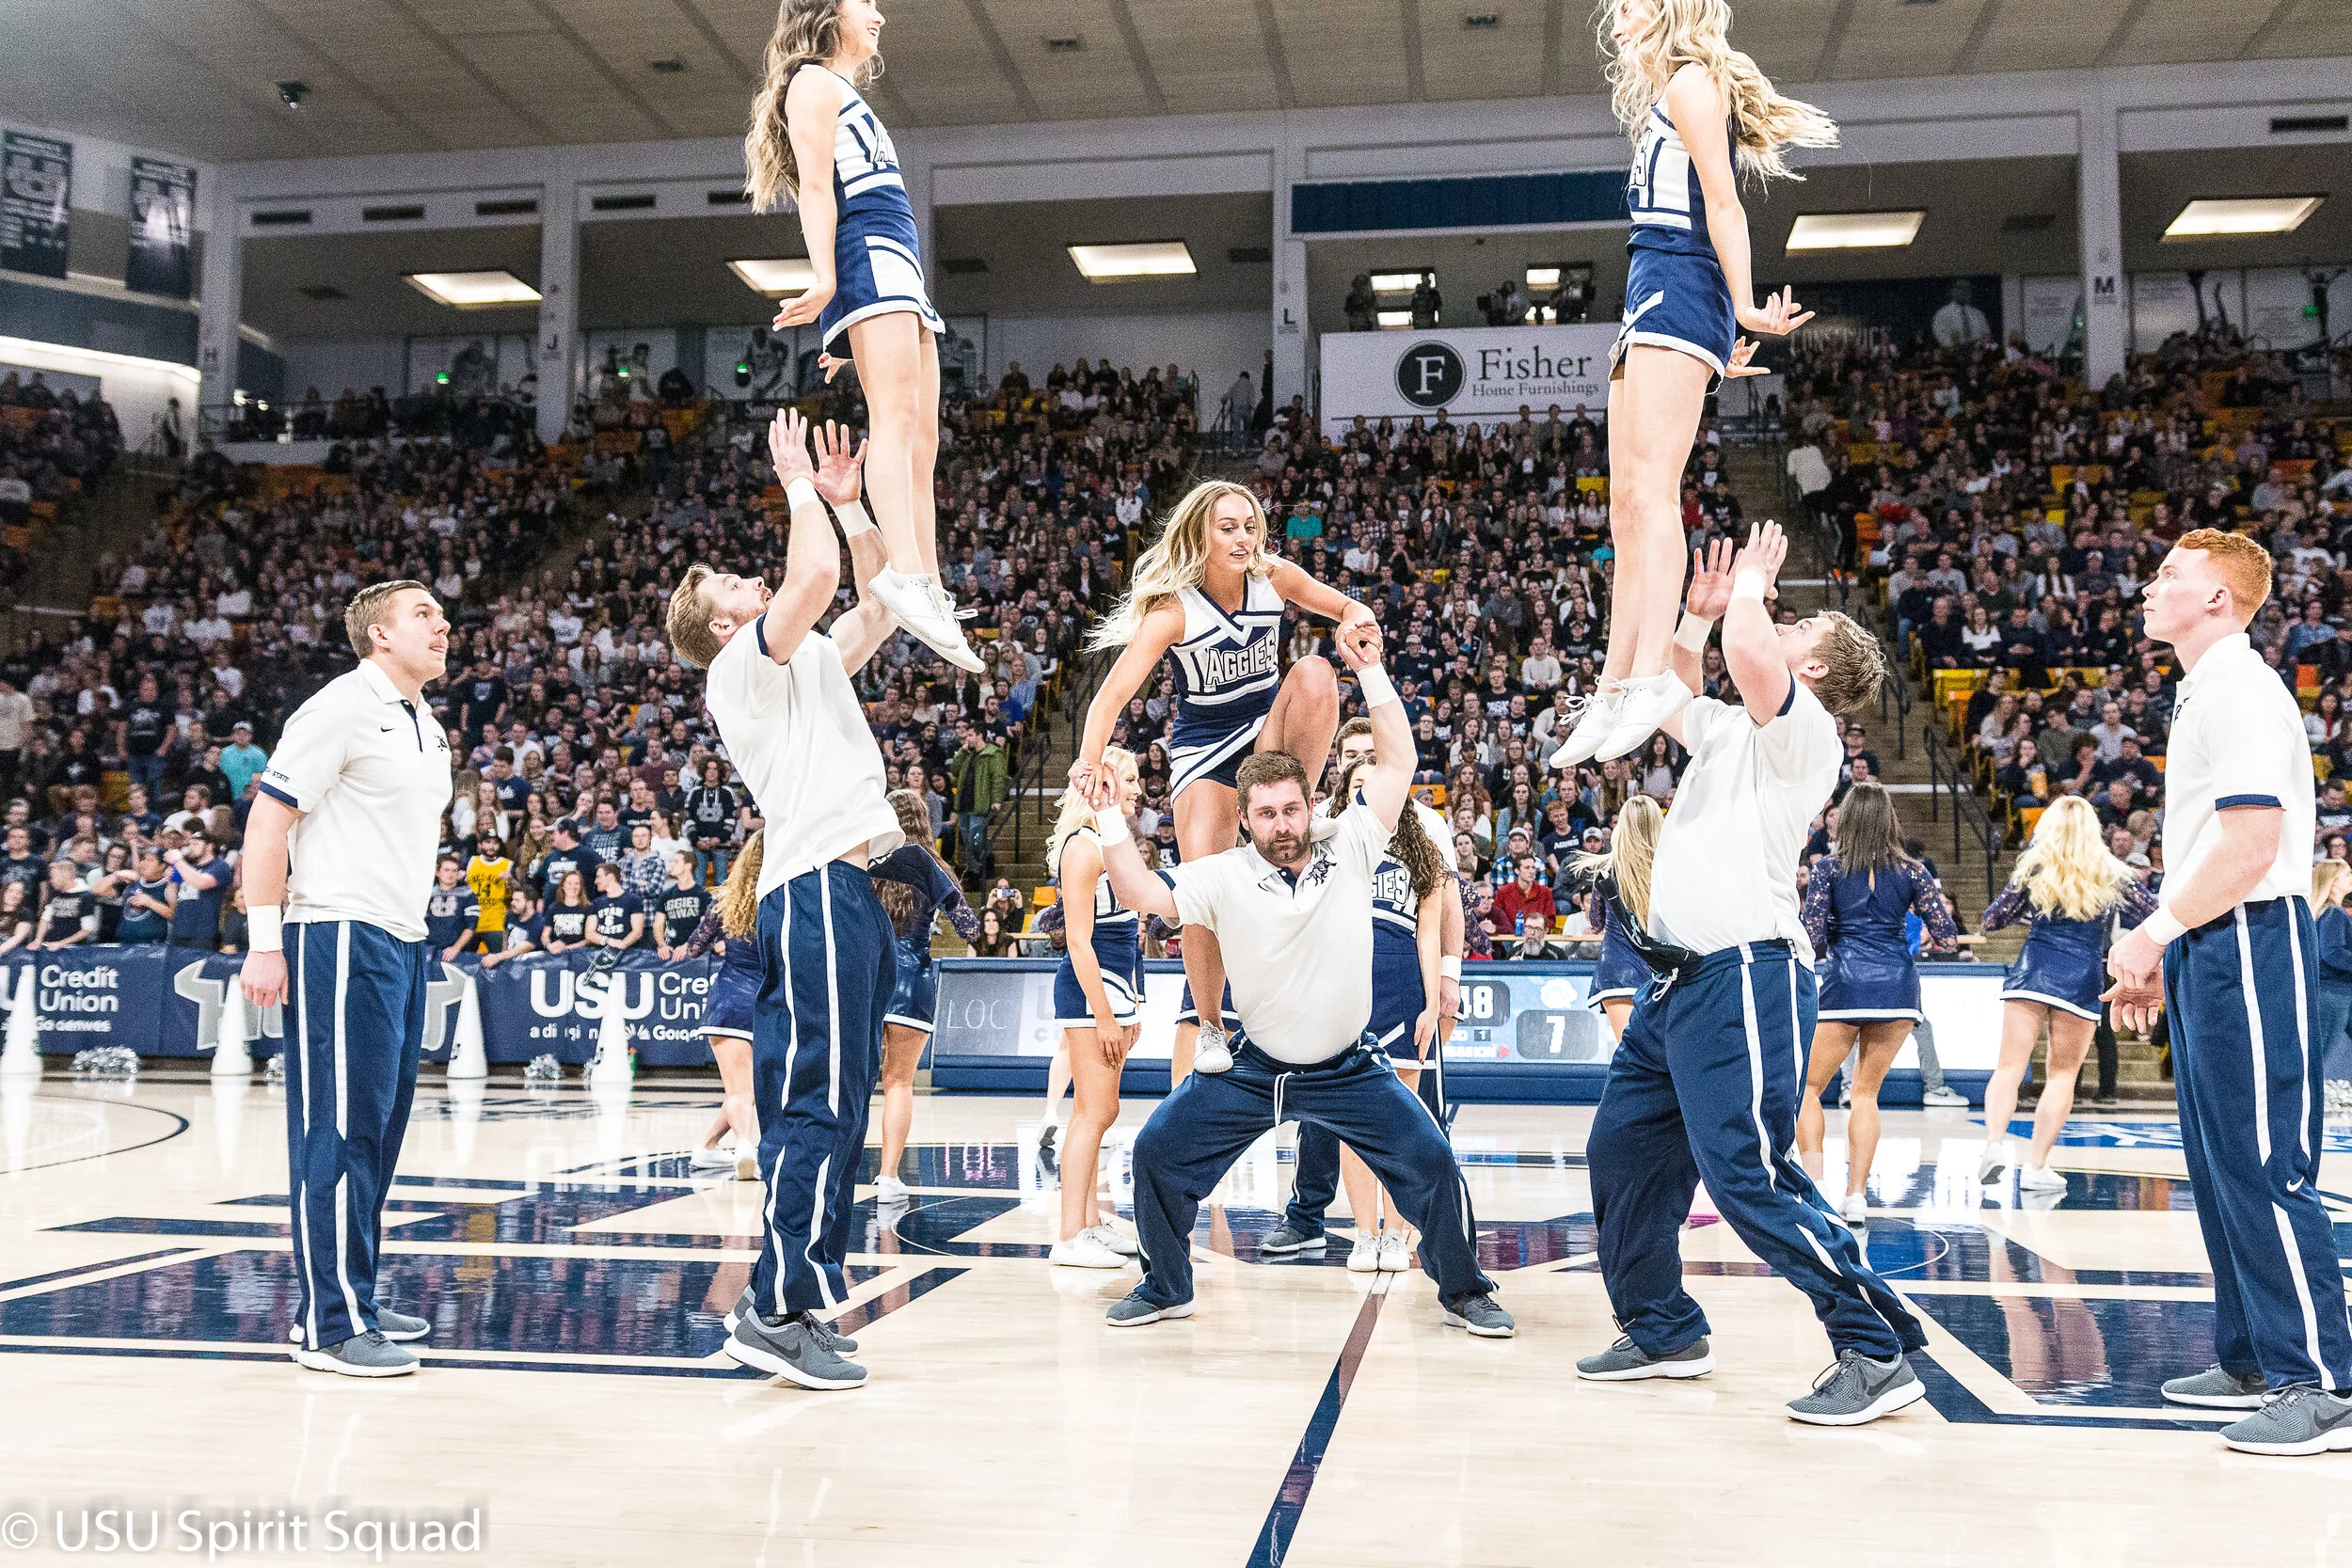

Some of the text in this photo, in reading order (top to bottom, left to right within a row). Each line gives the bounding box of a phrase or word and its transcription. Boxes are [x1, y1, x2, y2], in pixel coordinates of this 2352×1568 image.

[2094, 276, 2115, 294] M
[1283, 309, 1296, 325] L
[1476, 344, 1592, 381] Fisher
[1414, 355, 1446, 395] F
[1471, 380, 1599, 398] Home Furnishings
[1205, 626, 1278, 686] AGGIES
[272, 770, 290, 783] STATE
[40, 964, 119, 989] Credit
[40, 989, 119, 1012] Union
[530, 969, 655, 1021] USU
[1478, 1030, 1486, 1040] 1
[1546, 1015, 1566, 1053] 7
